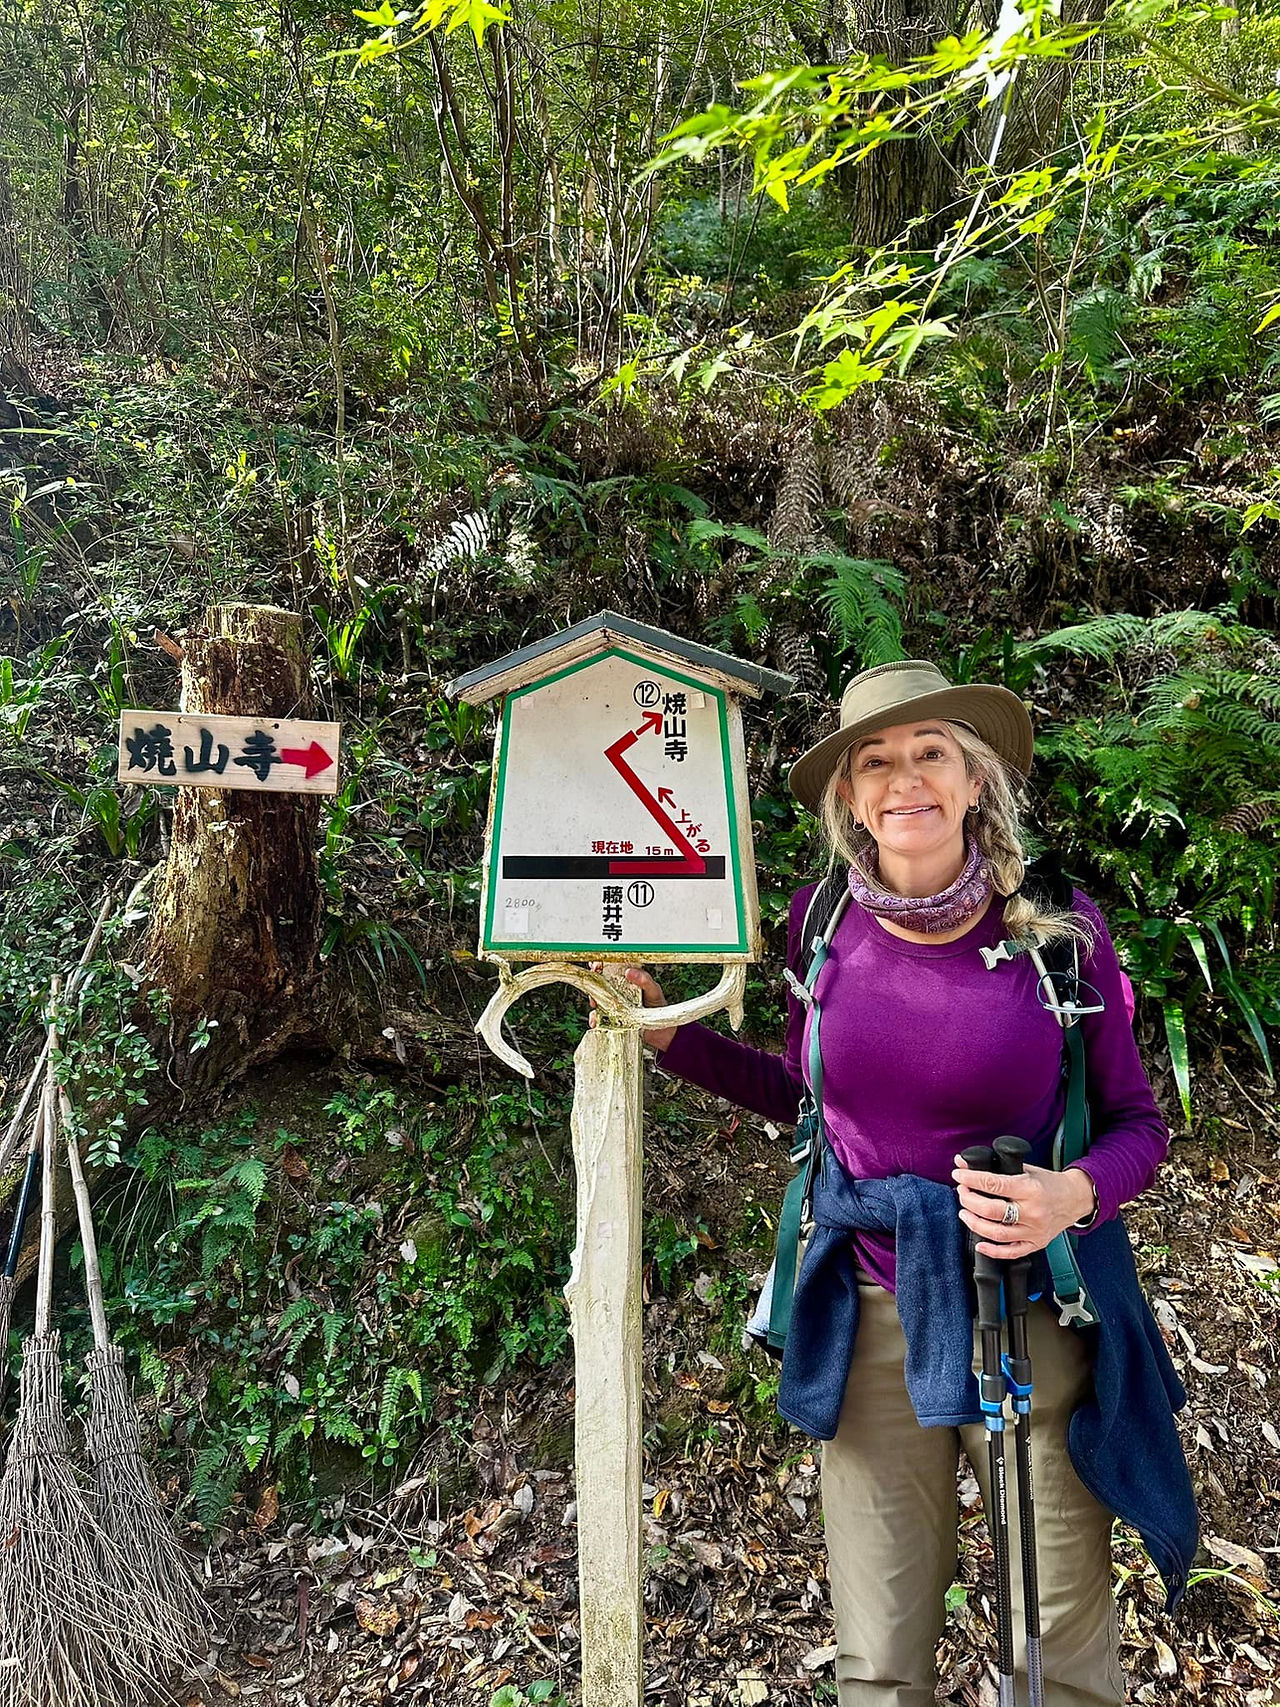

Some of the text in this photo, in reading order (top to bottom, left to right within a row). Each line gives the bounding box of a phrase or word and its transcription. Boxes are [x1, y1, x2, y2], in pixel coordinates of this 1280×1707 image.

[126, 723, 283, 782] 焼山寺
[662, 692, 688, 762] 焼山寺
[591, 840, 634, 855] 現在地
[675, 809, 711, 853] 上がる
[602, 885, 623, 941] 藤井寺
